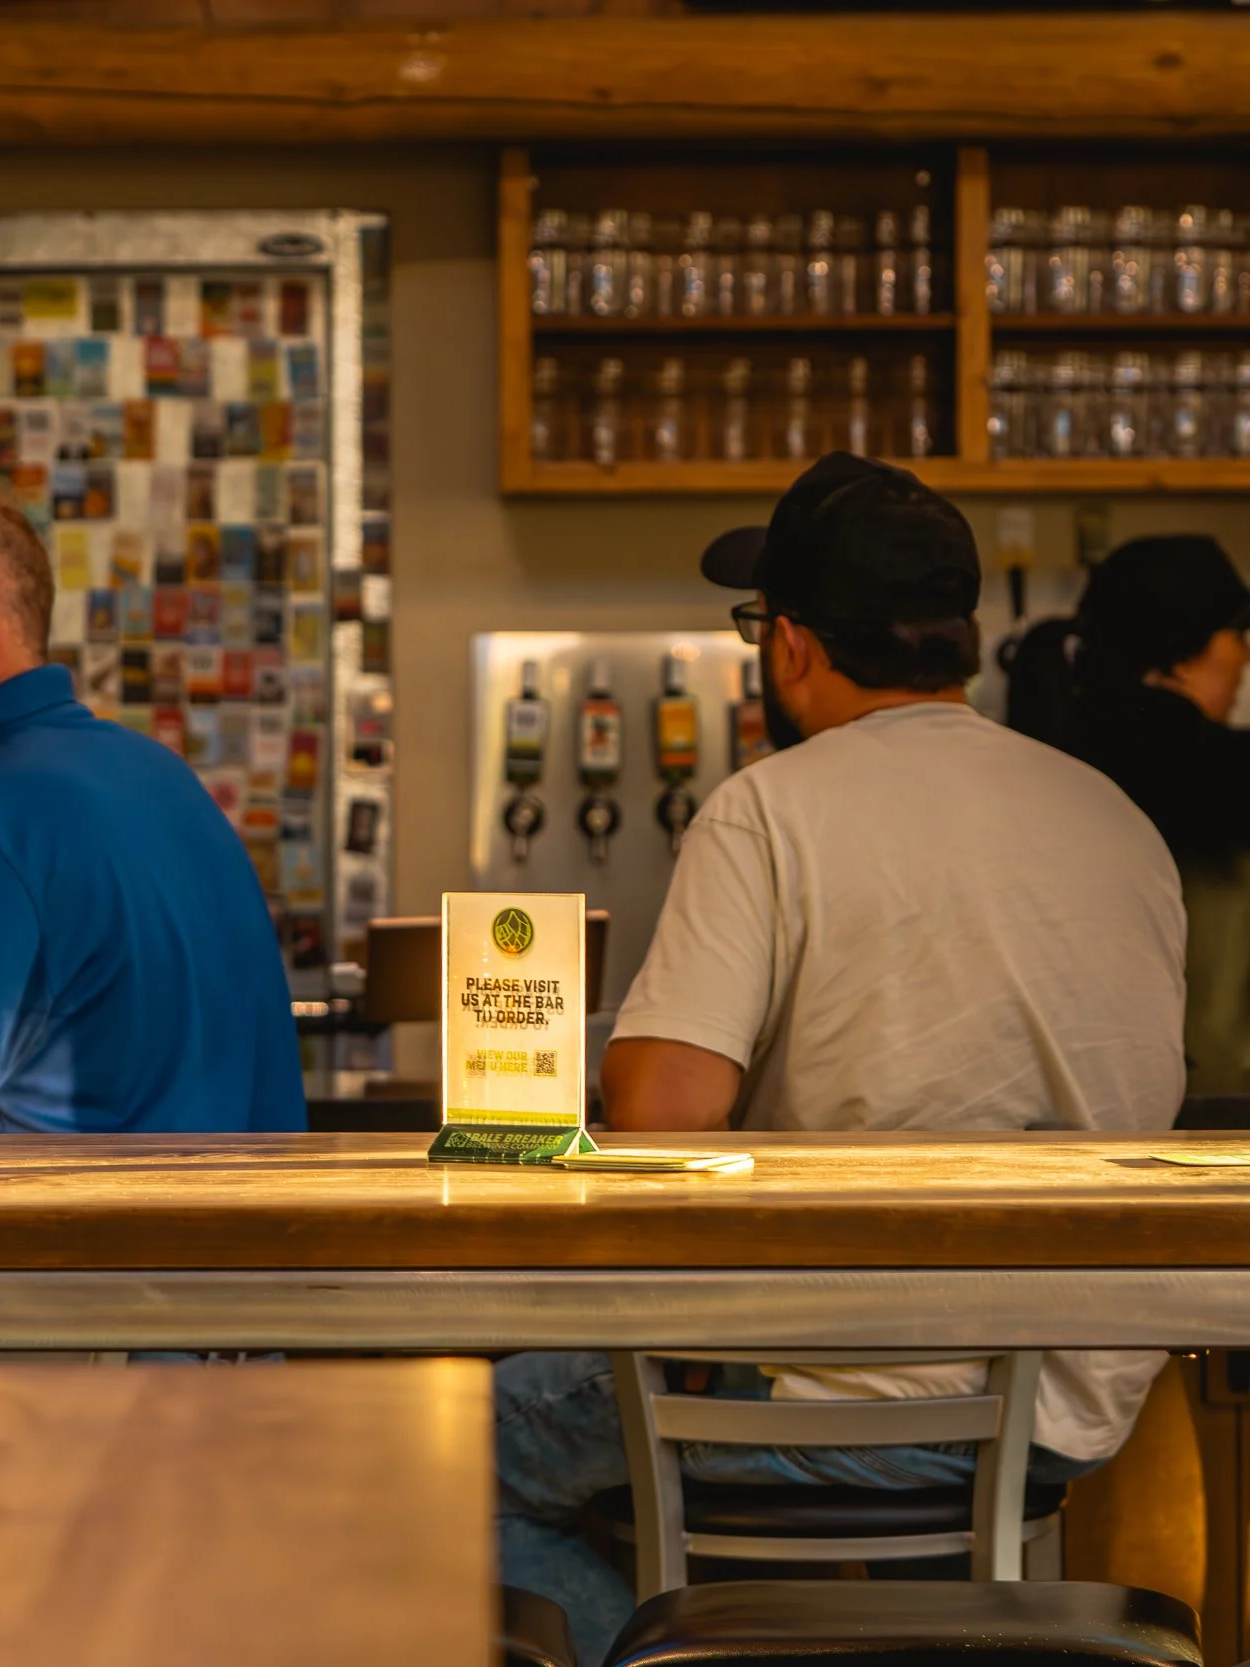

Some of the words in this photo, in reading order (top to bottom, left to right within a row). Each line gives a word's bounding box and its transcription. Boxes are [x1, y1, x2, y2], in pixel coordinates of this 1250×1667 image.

[466, 977, 520, 992] PLEASE
[523, 979, 560, 993] VISIT
[461, 993, 479, 1007] US
[483, 993, 500, 1008] AT
[503, 994, 531, 1009] THE
[535, 995, 564, 1010] BAR
[496, 1010, 549, 1025] ORDER.
[476, 1049, 504, 1060] VIEW
[506, 1050, 527, 1061] OUR
[499, 1061, 528, 1073] HERE
[470, 1133, 502, 1143] BALE
[504, 1133, 564, 1145] BREAKER
[465, 1142, 508, 1150] BREWING
[510, 1142, 561, 1151] COMPANY
